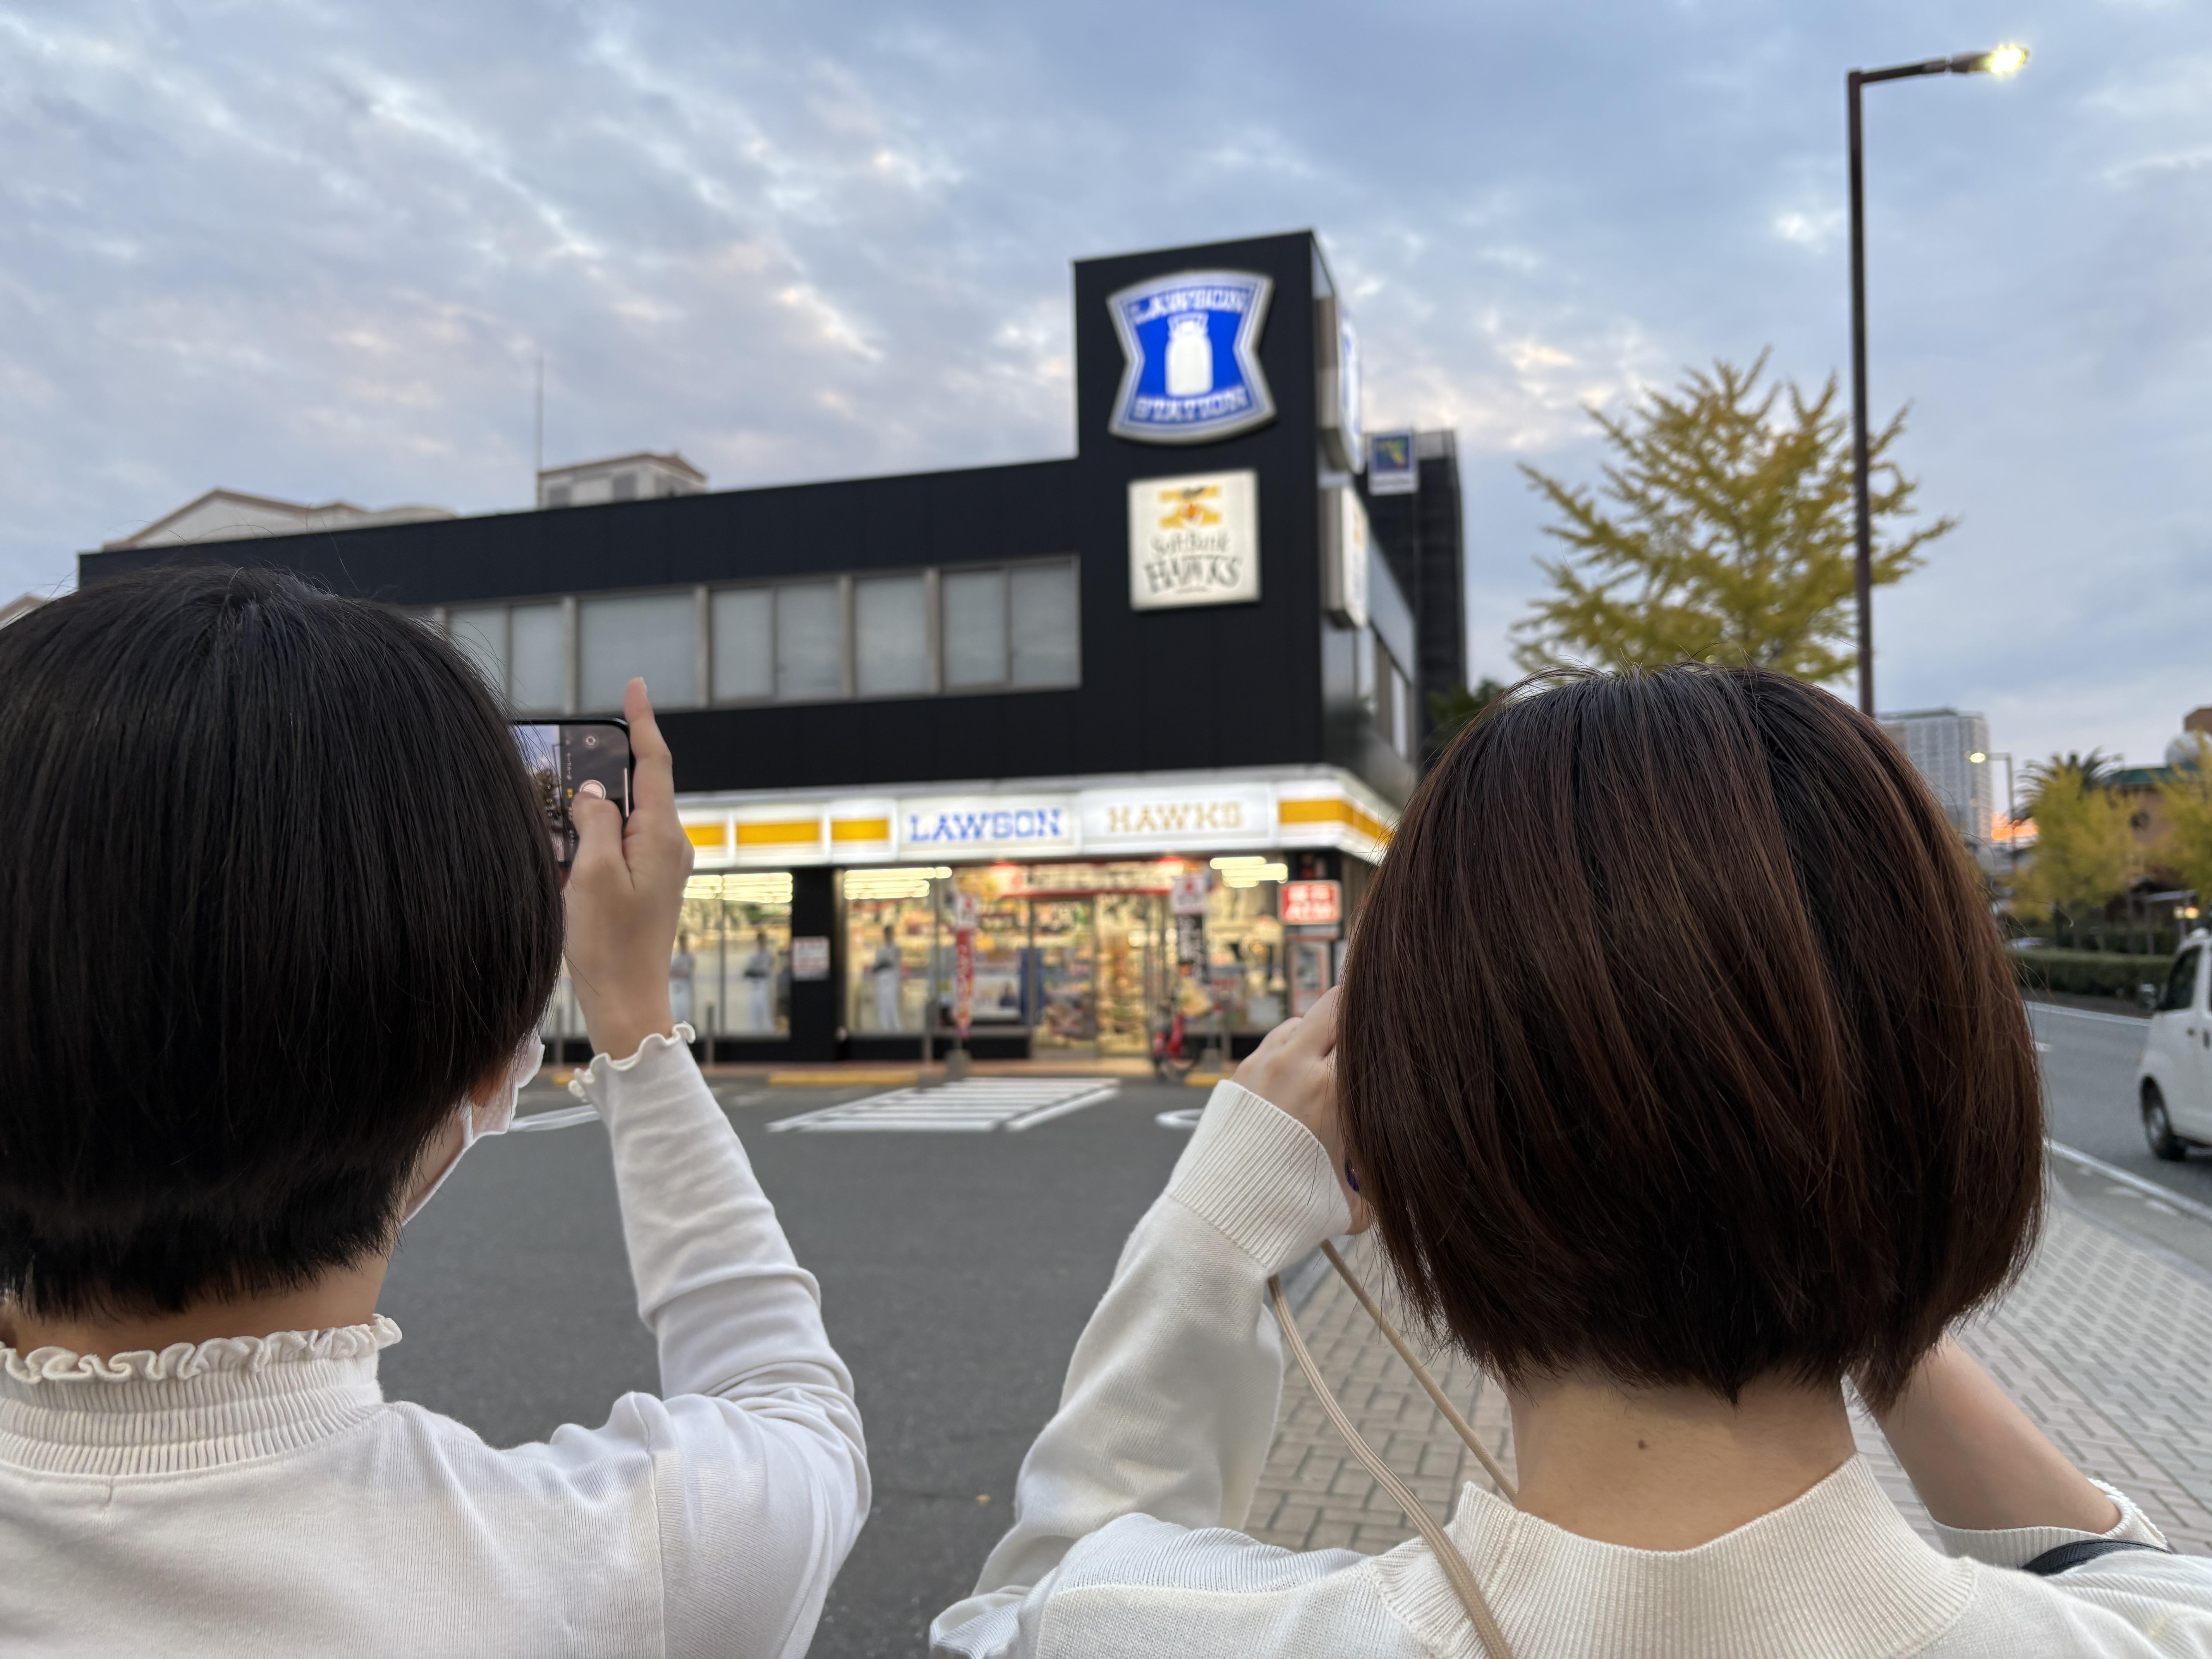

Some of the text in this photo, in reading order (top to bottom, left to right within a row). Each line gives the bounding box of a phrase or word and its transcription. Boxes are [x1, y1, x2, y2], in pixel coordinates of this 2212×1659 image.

[1131, 289, 1249, 325] LAWSON
[1133, 387, 1248, 421] STATION
[910, 808, 1061, 842] LAWSON
[1108, 802, 1242, 832] HAWKS
